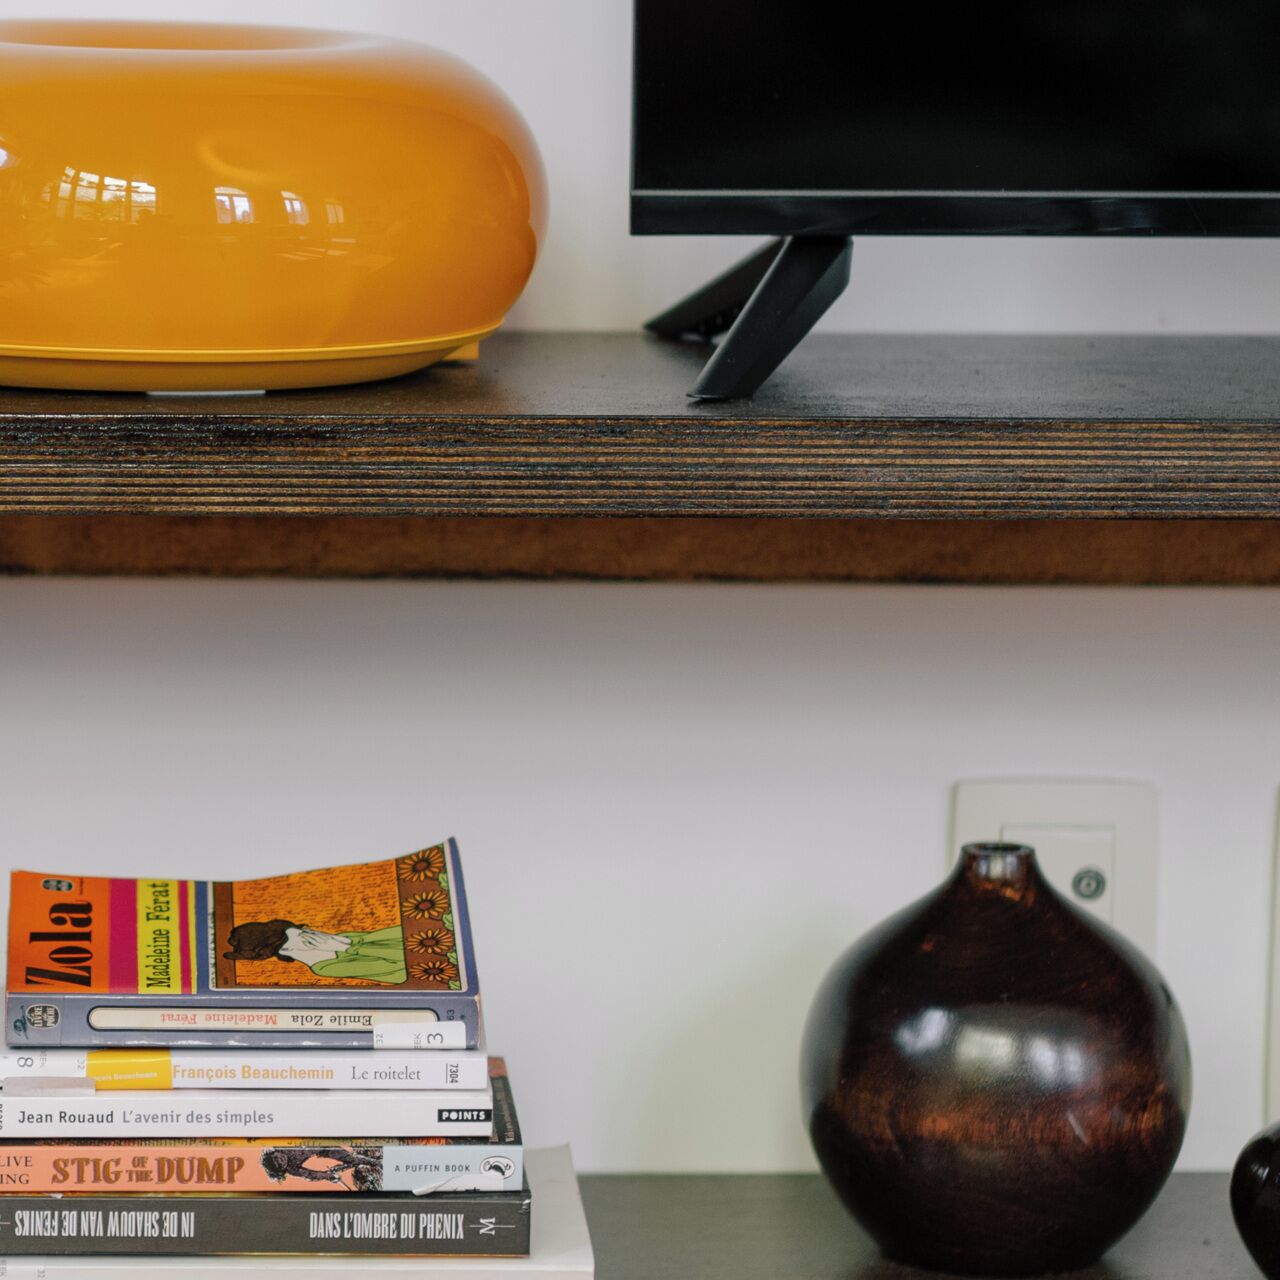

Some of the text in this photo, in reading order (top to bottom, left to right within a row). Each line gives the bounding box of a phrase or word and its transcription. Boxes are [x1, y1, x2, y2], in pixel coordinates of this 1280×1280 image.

[25, 900, 93, 987] Zola
[145, 882, 170, 988] Madeleine Férat
[160, 1013, 373, 1026] Emile Zola Madeleine Férat
[426, 1032, 444, 1045] 3
[16, 1056, 34, 1068] 8
[172, 1064, 335, 1083] François Beauchemin
[351, 1065, 421, 1081] Le roitelet
[449, 1063, 459, 1084] 7304
[18, 1110, 115, 1124] Jean Rouaud
[122, 1110, 274, 1127] L'avenir des simples
[441, 1111, 486, 1121] POINTS
[51, 1155, 245, 1185] STIG OF THE DUMP
[394, 1164, 471, 1173] A PUFFIN BOOK
[14, 1210, 195, 1238] IN DE SHADUW VAN DE FENIKS
[309, 1212, 465, 1239] DANS L'OMBRE DU PHENIX
